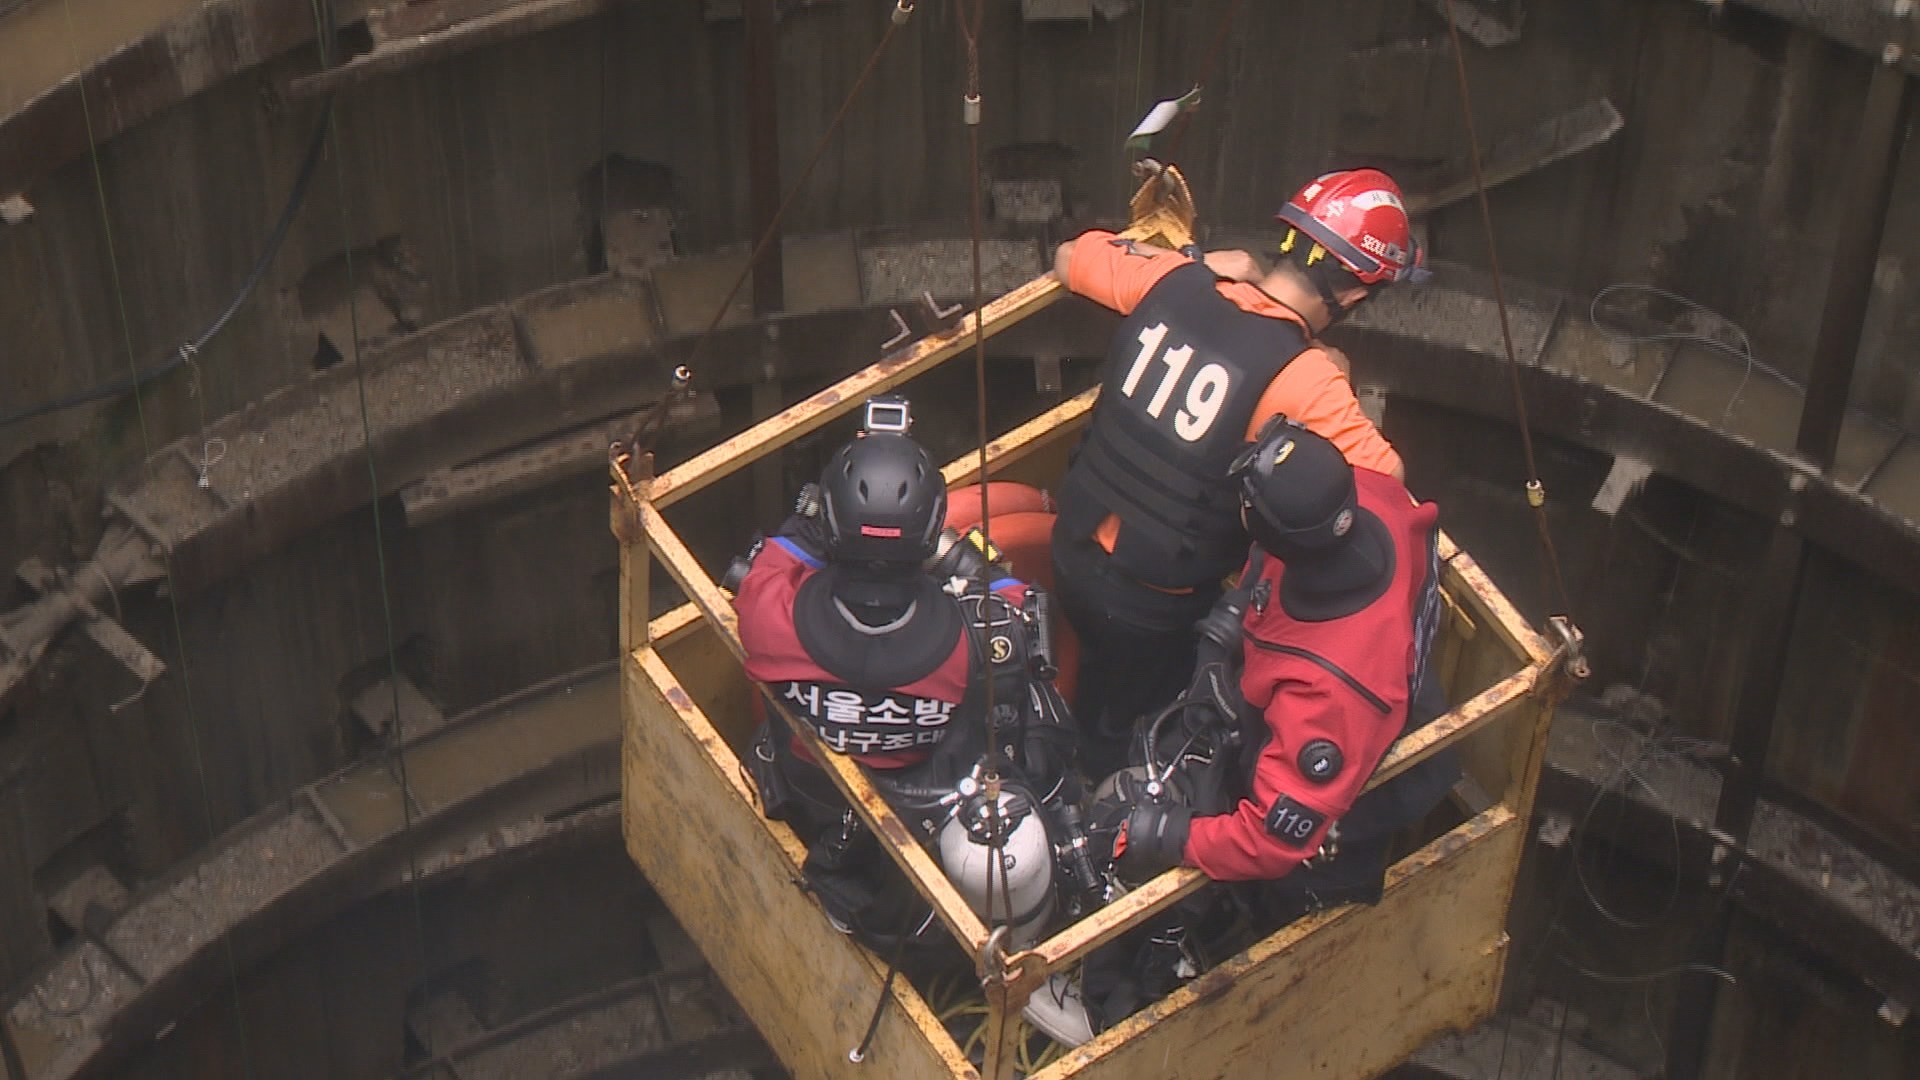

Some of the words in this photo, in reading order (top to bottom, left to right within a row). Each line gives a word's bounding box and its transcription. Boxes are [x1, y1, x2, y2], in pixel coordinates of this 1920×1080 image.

[1360, 234, 1387, 256] SEOUL
[1121, 322, 1229, 441] 119
[784, 682, 957, 726] 서울소방
[802, 718, 946, 752] 난구조대
[1273, 808, 1313, 838] 119
